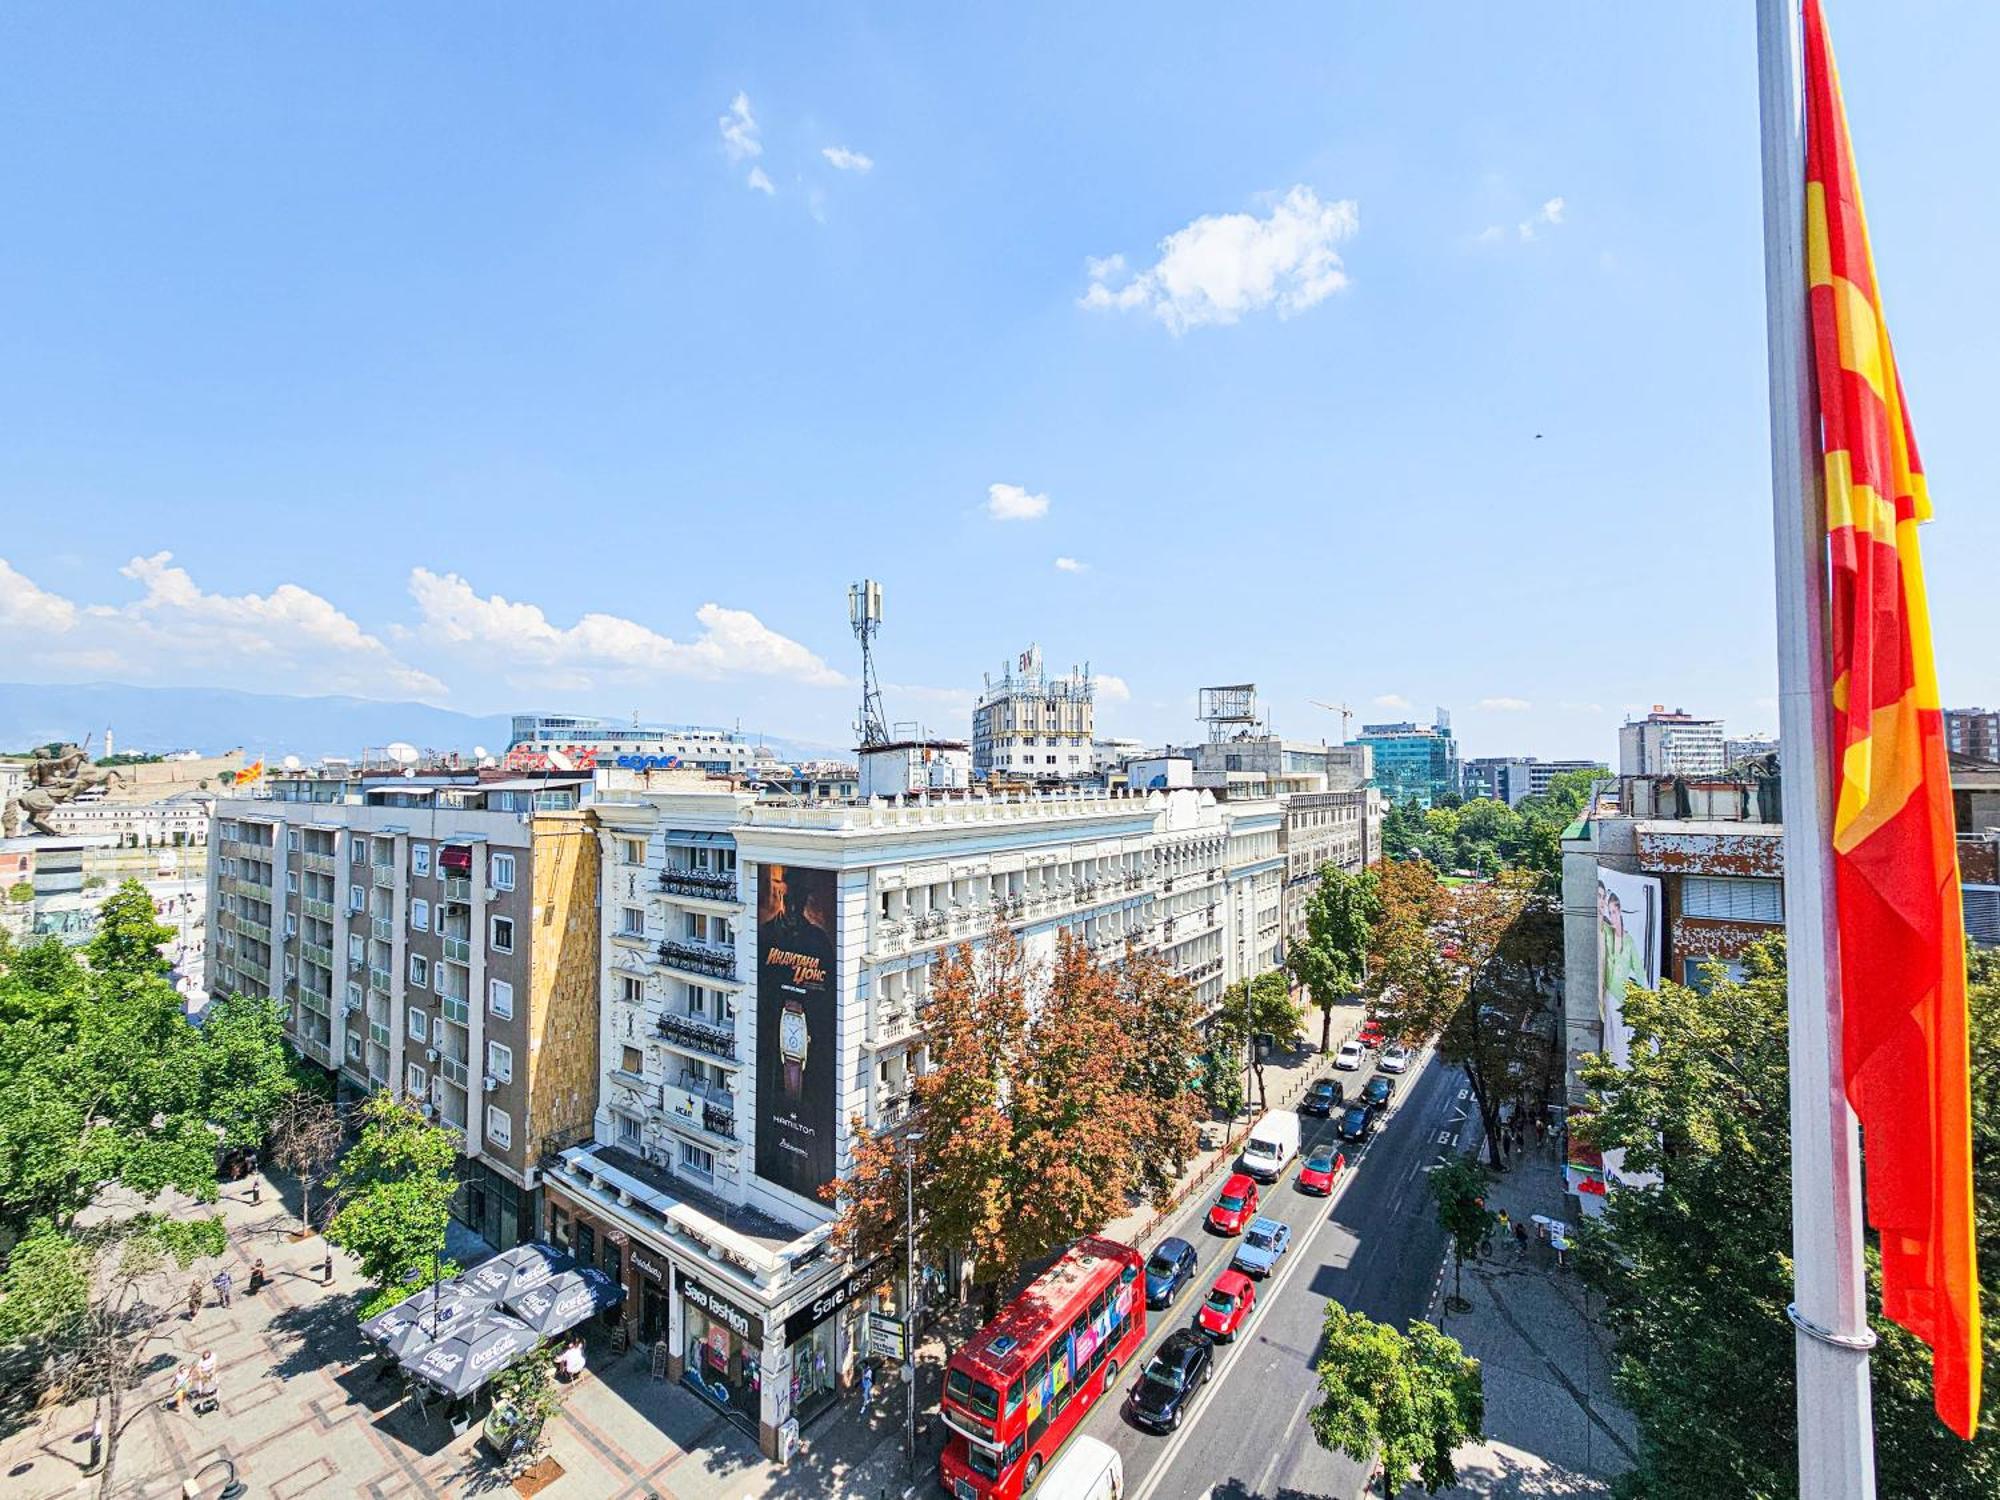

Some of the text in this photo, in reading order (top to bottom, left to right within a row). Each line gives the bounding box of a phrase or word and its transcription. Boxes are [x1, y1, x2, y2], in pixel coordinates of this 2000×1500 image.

[684, 1280, 749, 1337] Sara fashion
[812, 1289, 845, 1321] Sara
